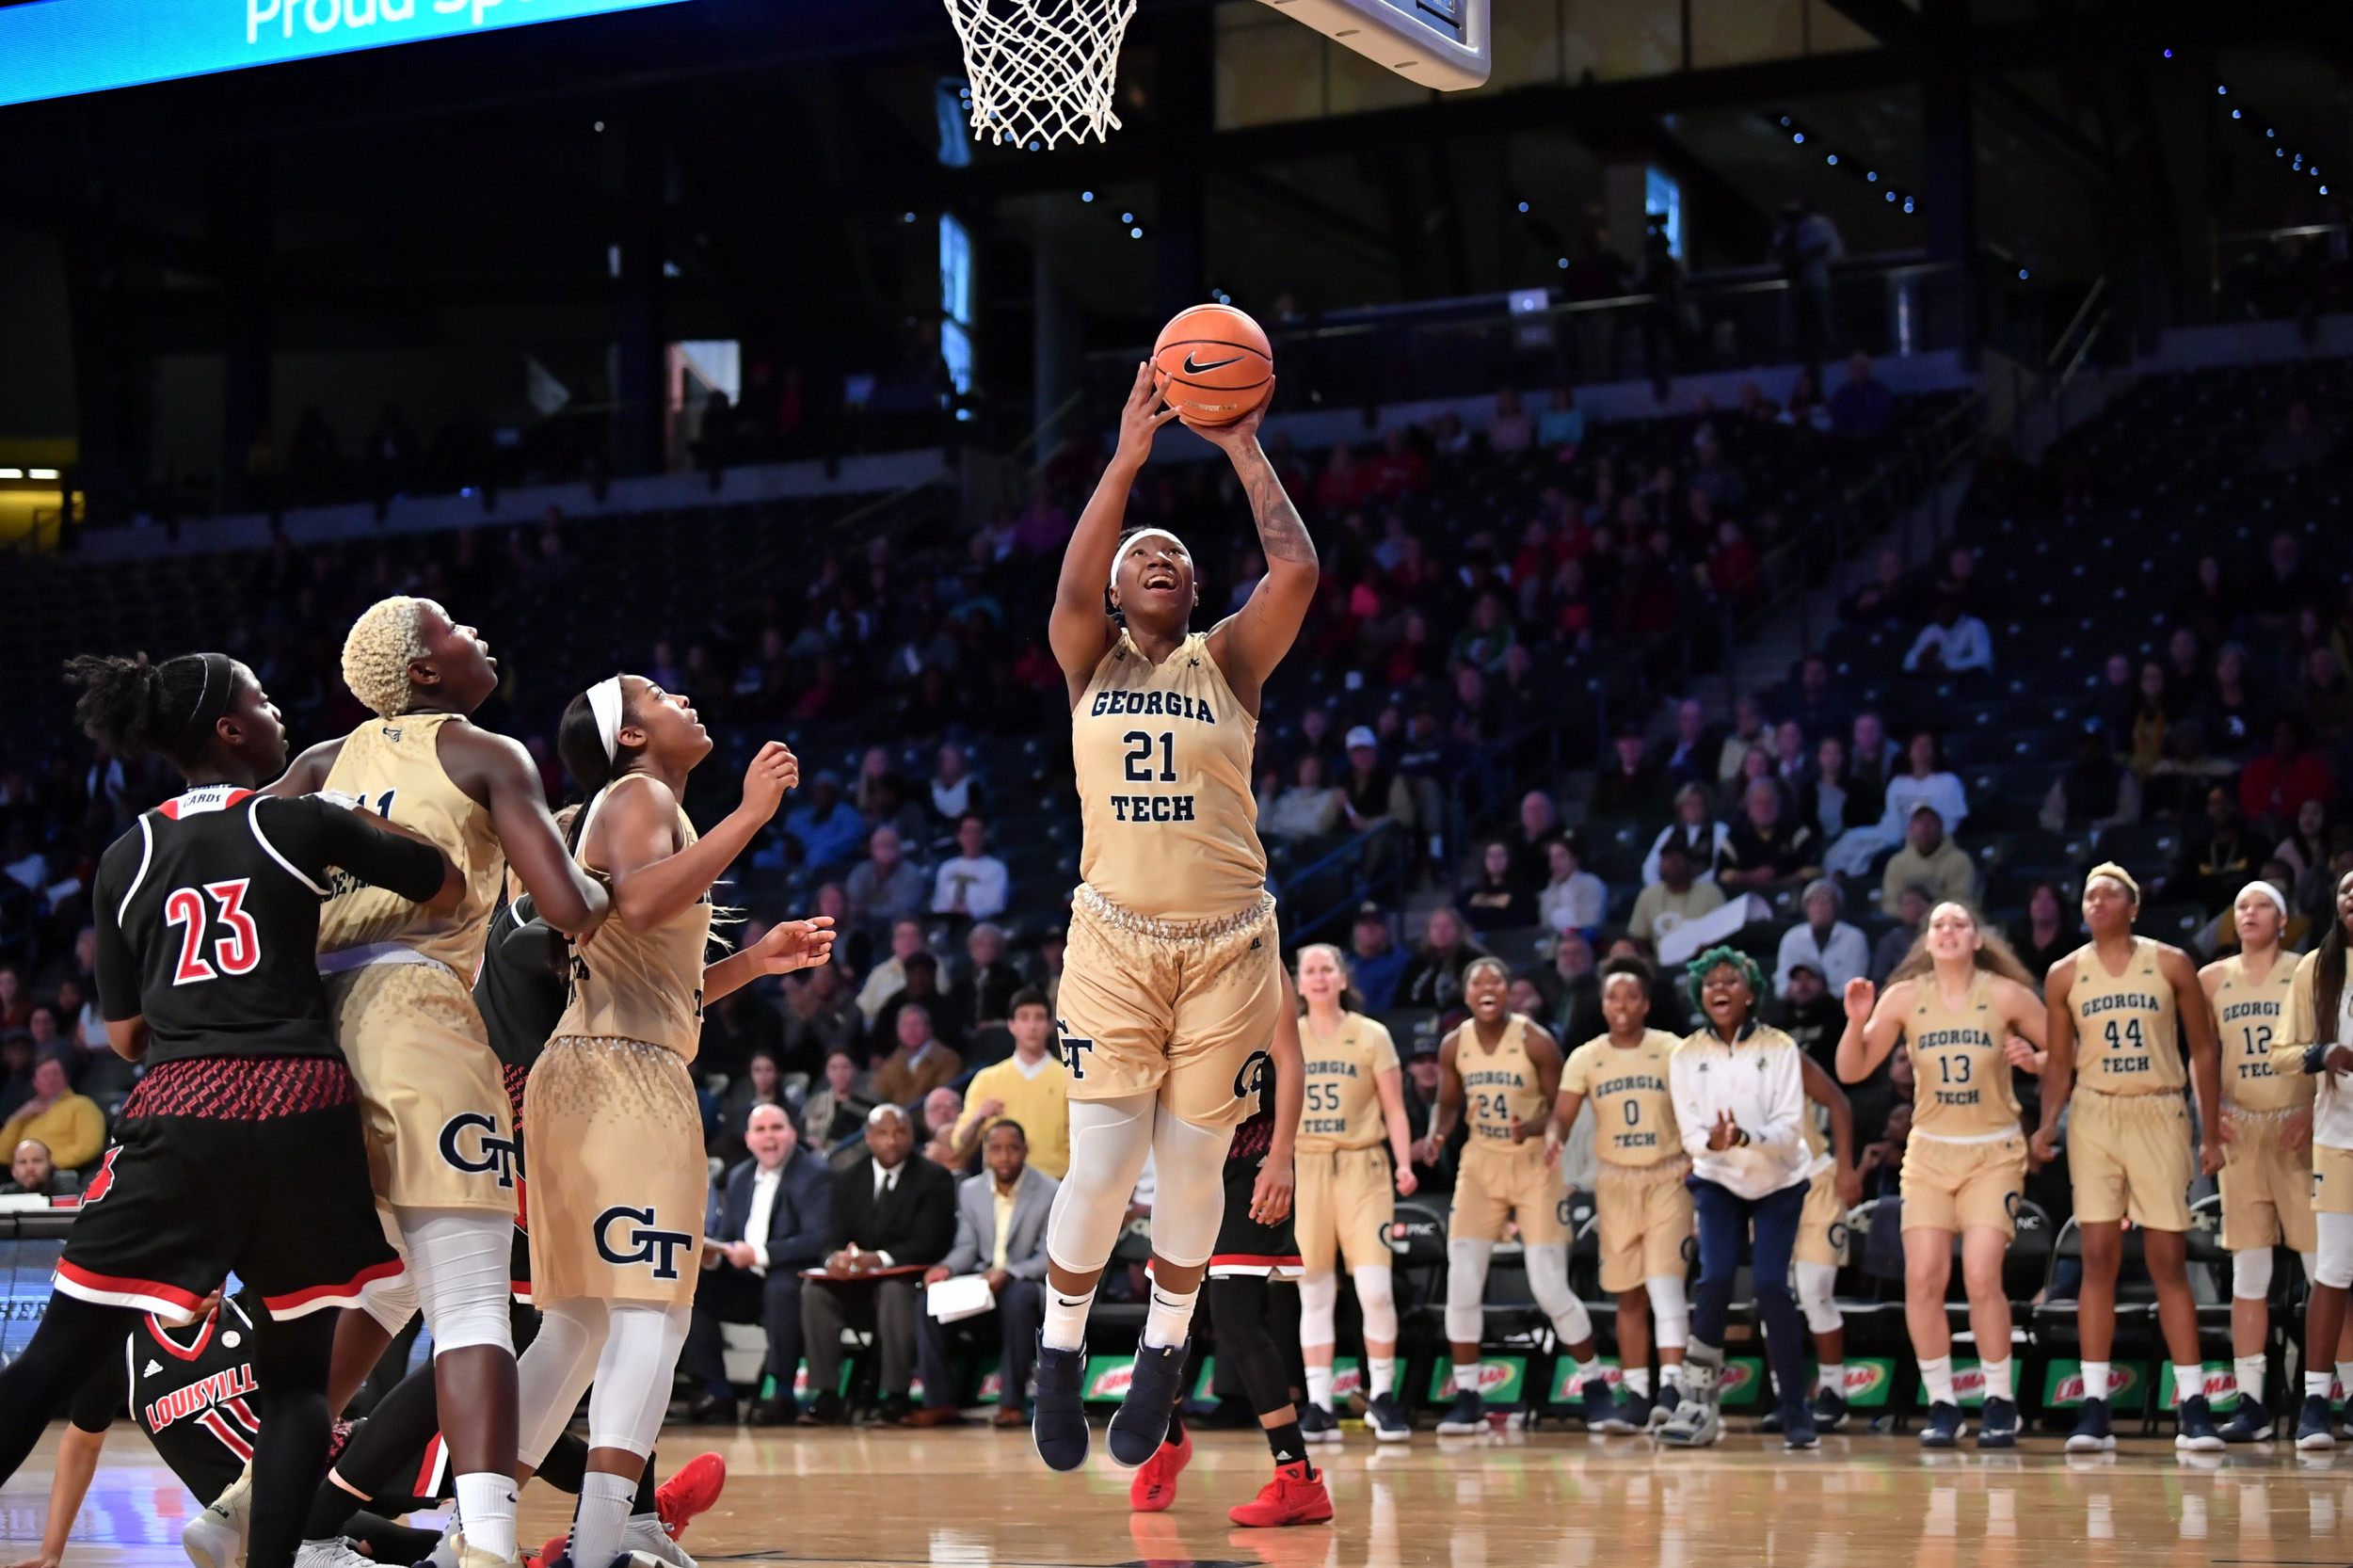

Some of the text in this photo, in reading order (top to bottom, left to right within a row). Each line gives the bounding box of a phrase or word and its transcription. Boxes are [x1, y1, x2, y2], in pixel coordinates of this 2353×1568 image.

[1091, 690, 1216, 725] GEORGIA
[1123, 730, 1176, 782] 21
[1110, 794, 1195, 822] TECH
[165, 877, 261, 986] 23
[2082, 993, 2159, 1017] GEORGIA
[2223, 1000, 2280, 1021] GEORGI
[1918, 1029, 1993, 1049] GEORGIA
[2105, 1018, 2143, 1048] 44
[2243, 1026, 2271, 1054] 12
[1305, 1060, 1357, 1079] ORGIA
[1939, 1055, 1971, 1083] 13
[2102, 1056, 2150, 1073] TECH
[2238, 1063, 2280, 1079] TEC
[1306, 1082, 1340, 1112] 55
[1596, 1076, 1666, 1098] GEORGIA
[1935, 1090, 1979, 1105] TECH
[1477, 1093, 1509, 1120] 24
[1624, 1099, 1640, 1127] 0
[1304, 1118, 1346, 1133] TECH
[1613, 1132, 1657, 1148] TECH
[2017, 1217, 2040, 1230] NC
[593, 1205, 693, 1280] GT
[145, 1363, 259, 1434] LOUISVILL
